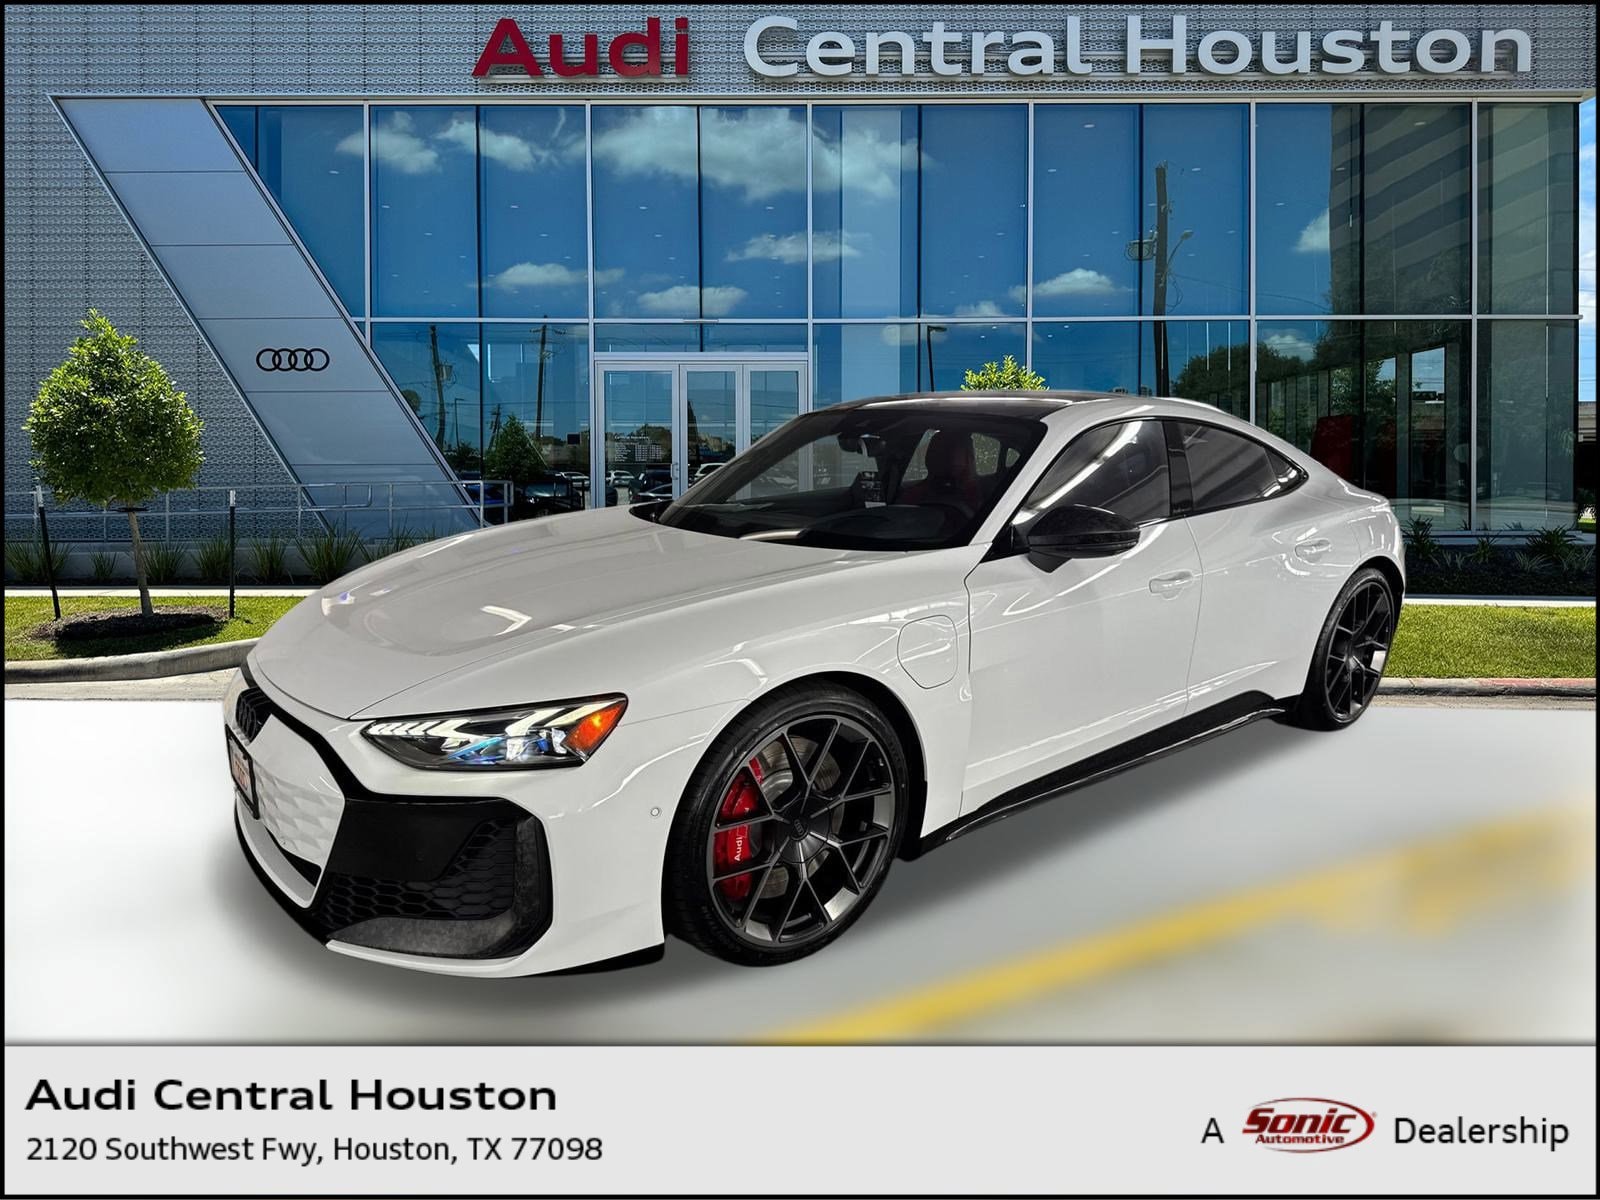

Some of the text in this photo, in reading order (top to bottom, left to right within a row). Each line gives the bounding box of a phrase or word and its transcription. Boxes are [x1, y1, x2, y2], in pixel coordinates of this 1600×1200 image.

[473, 15, 1532, 77] Audi Central Houston
[734, 836, 743, 861] Audi
